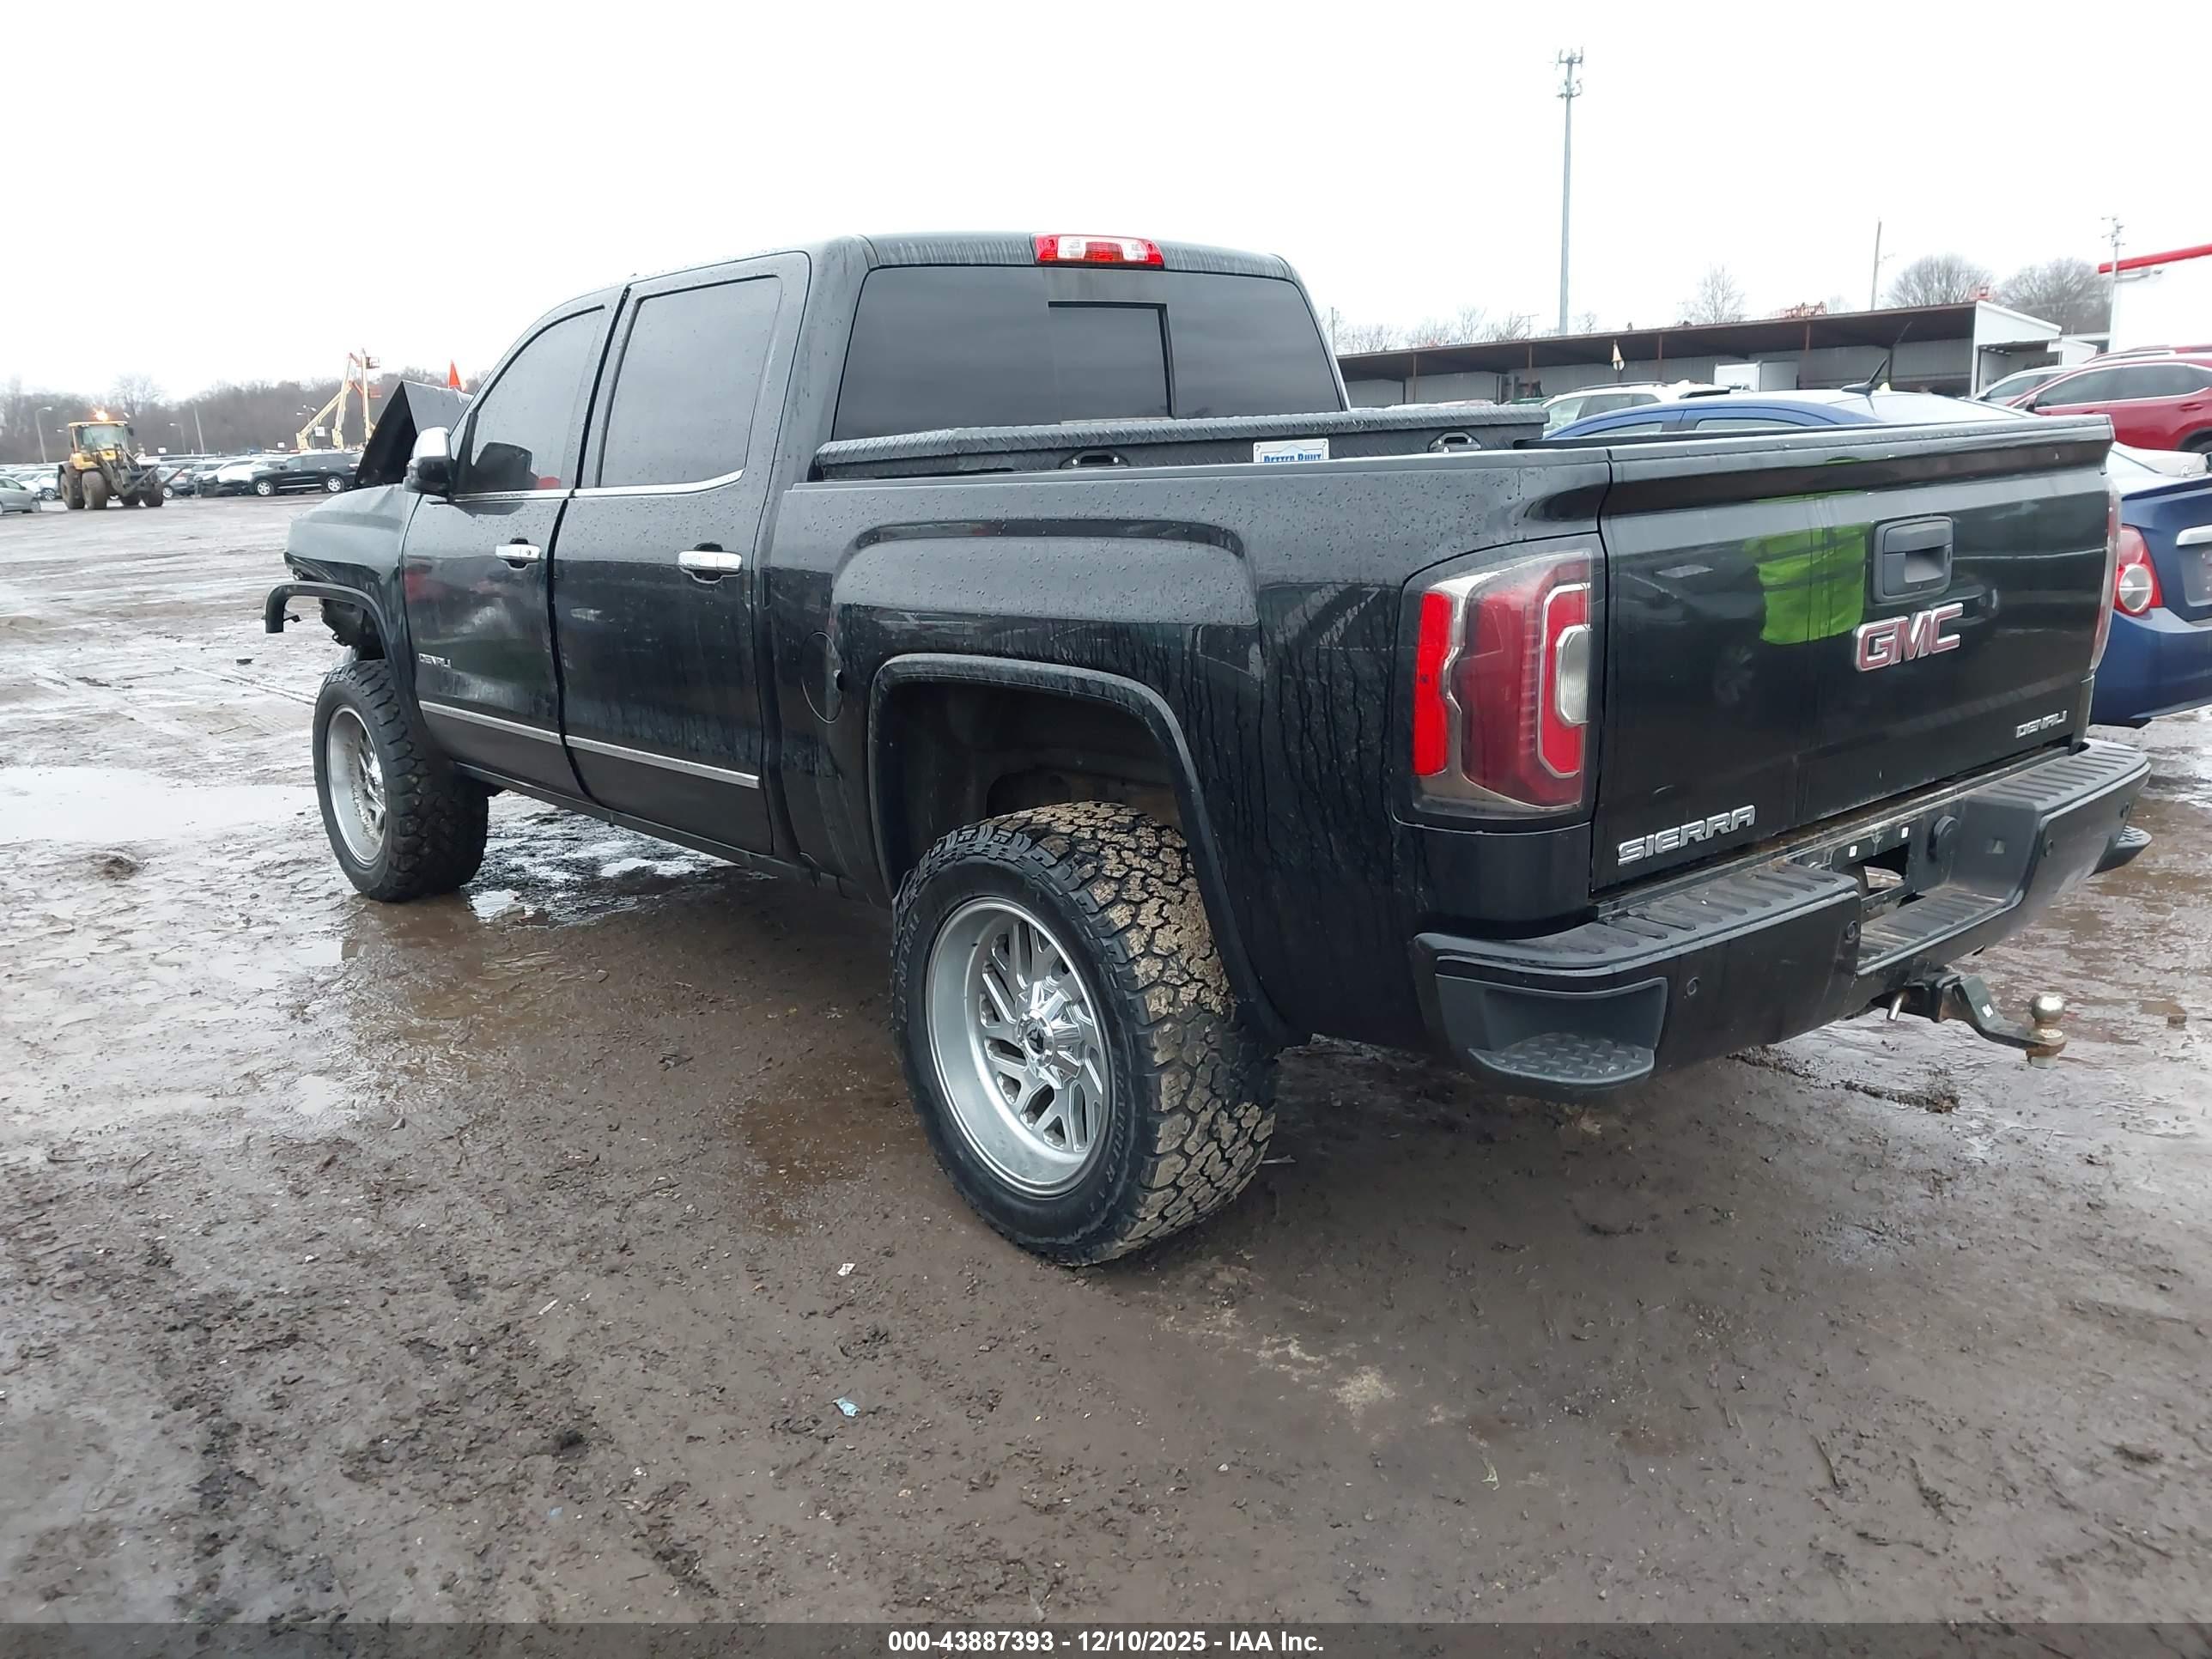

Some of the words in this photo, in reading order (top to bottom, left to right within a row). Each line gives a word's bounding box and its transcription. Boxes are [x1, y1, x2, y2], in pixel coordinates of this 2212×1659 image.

[1856, 602, 1964, 672] GMC
[2015, 709, 2068, 738] DENALI
[1617, 805, 1756, 866] SIERRA
